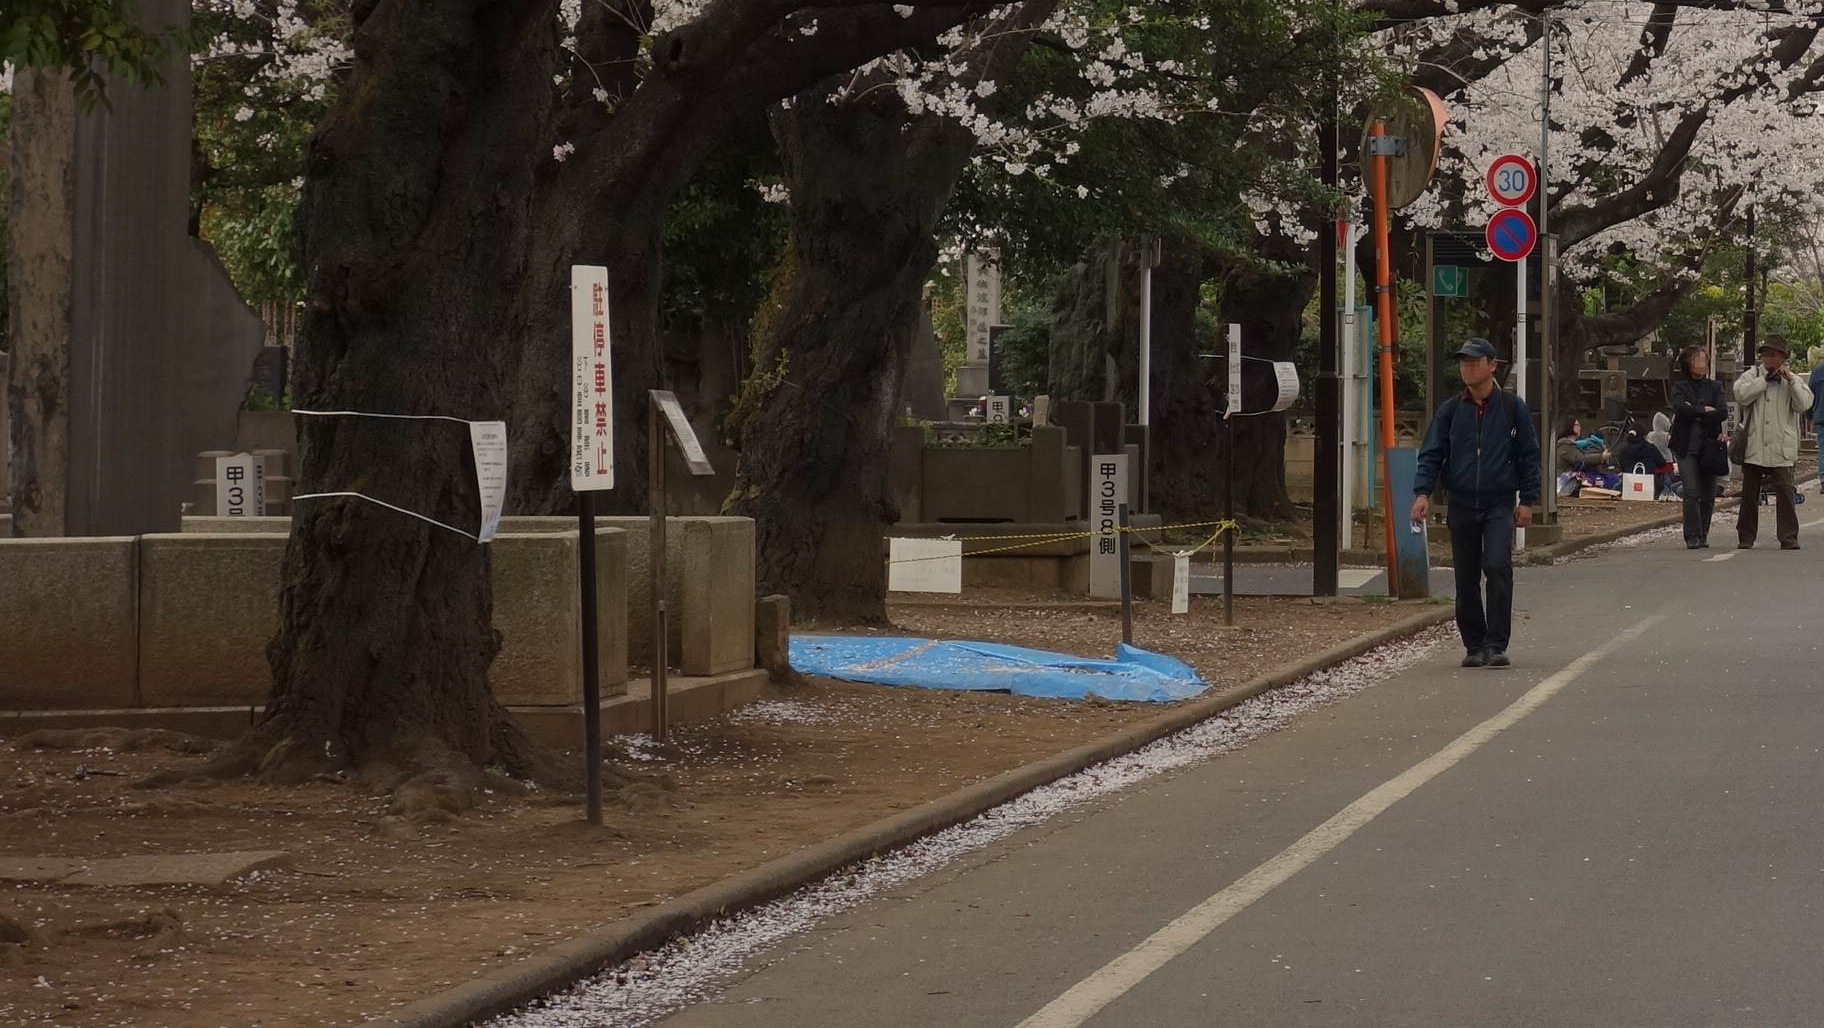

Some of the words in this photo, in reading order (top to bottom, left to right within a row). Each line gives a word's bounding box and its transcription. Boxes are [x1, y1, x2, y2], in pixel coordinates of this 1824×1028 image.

[1498, 170, 1525, 192] 30
[592, 282, 608, 475] 駐停車禁止
[1099, 463, 1116, 555] 甲3号8側
